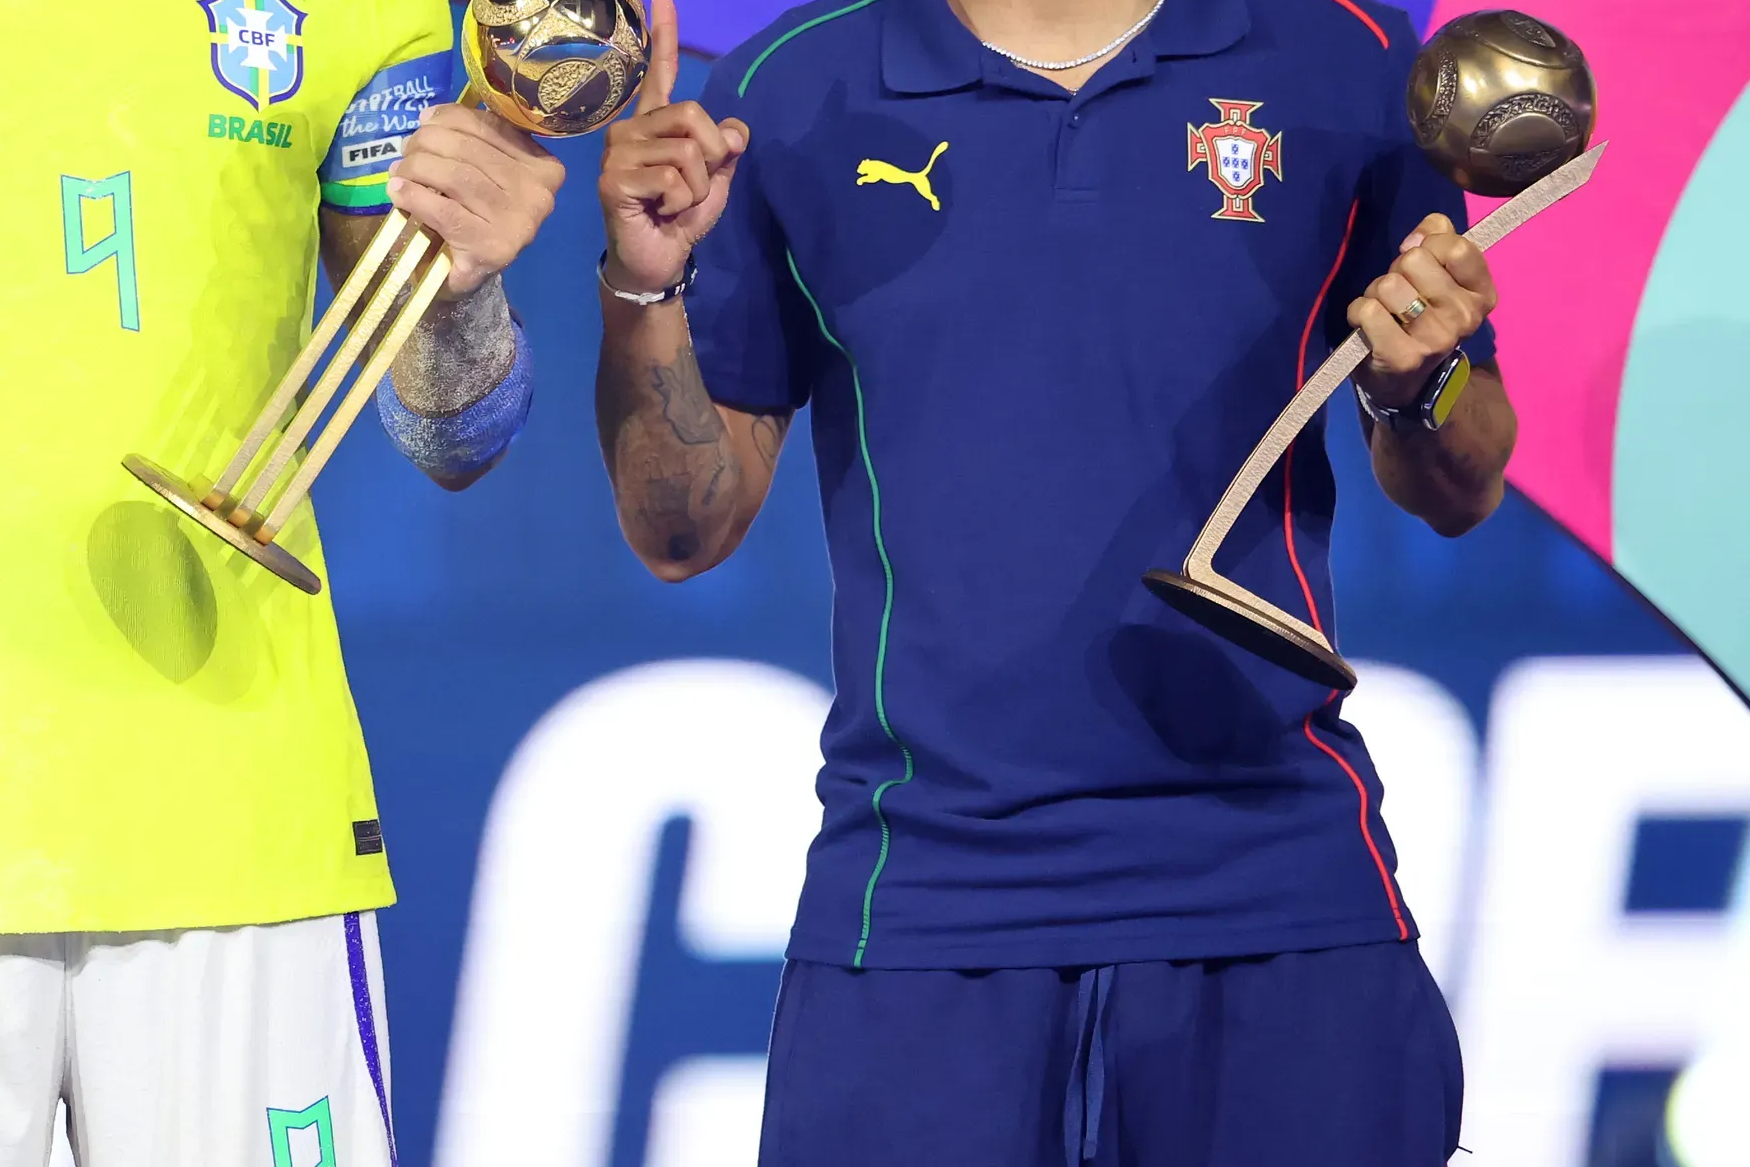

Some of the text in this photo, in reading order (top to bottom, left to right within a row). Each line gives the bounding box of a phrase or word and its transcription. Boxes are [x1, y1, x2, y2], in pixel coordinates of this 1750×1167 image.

[238, 29, 275, 47] CBF
[207, 113, 294, 149] BRASIL
[348, 141, 398, 162] FIFA
[60, 170, 140, 332] 9
